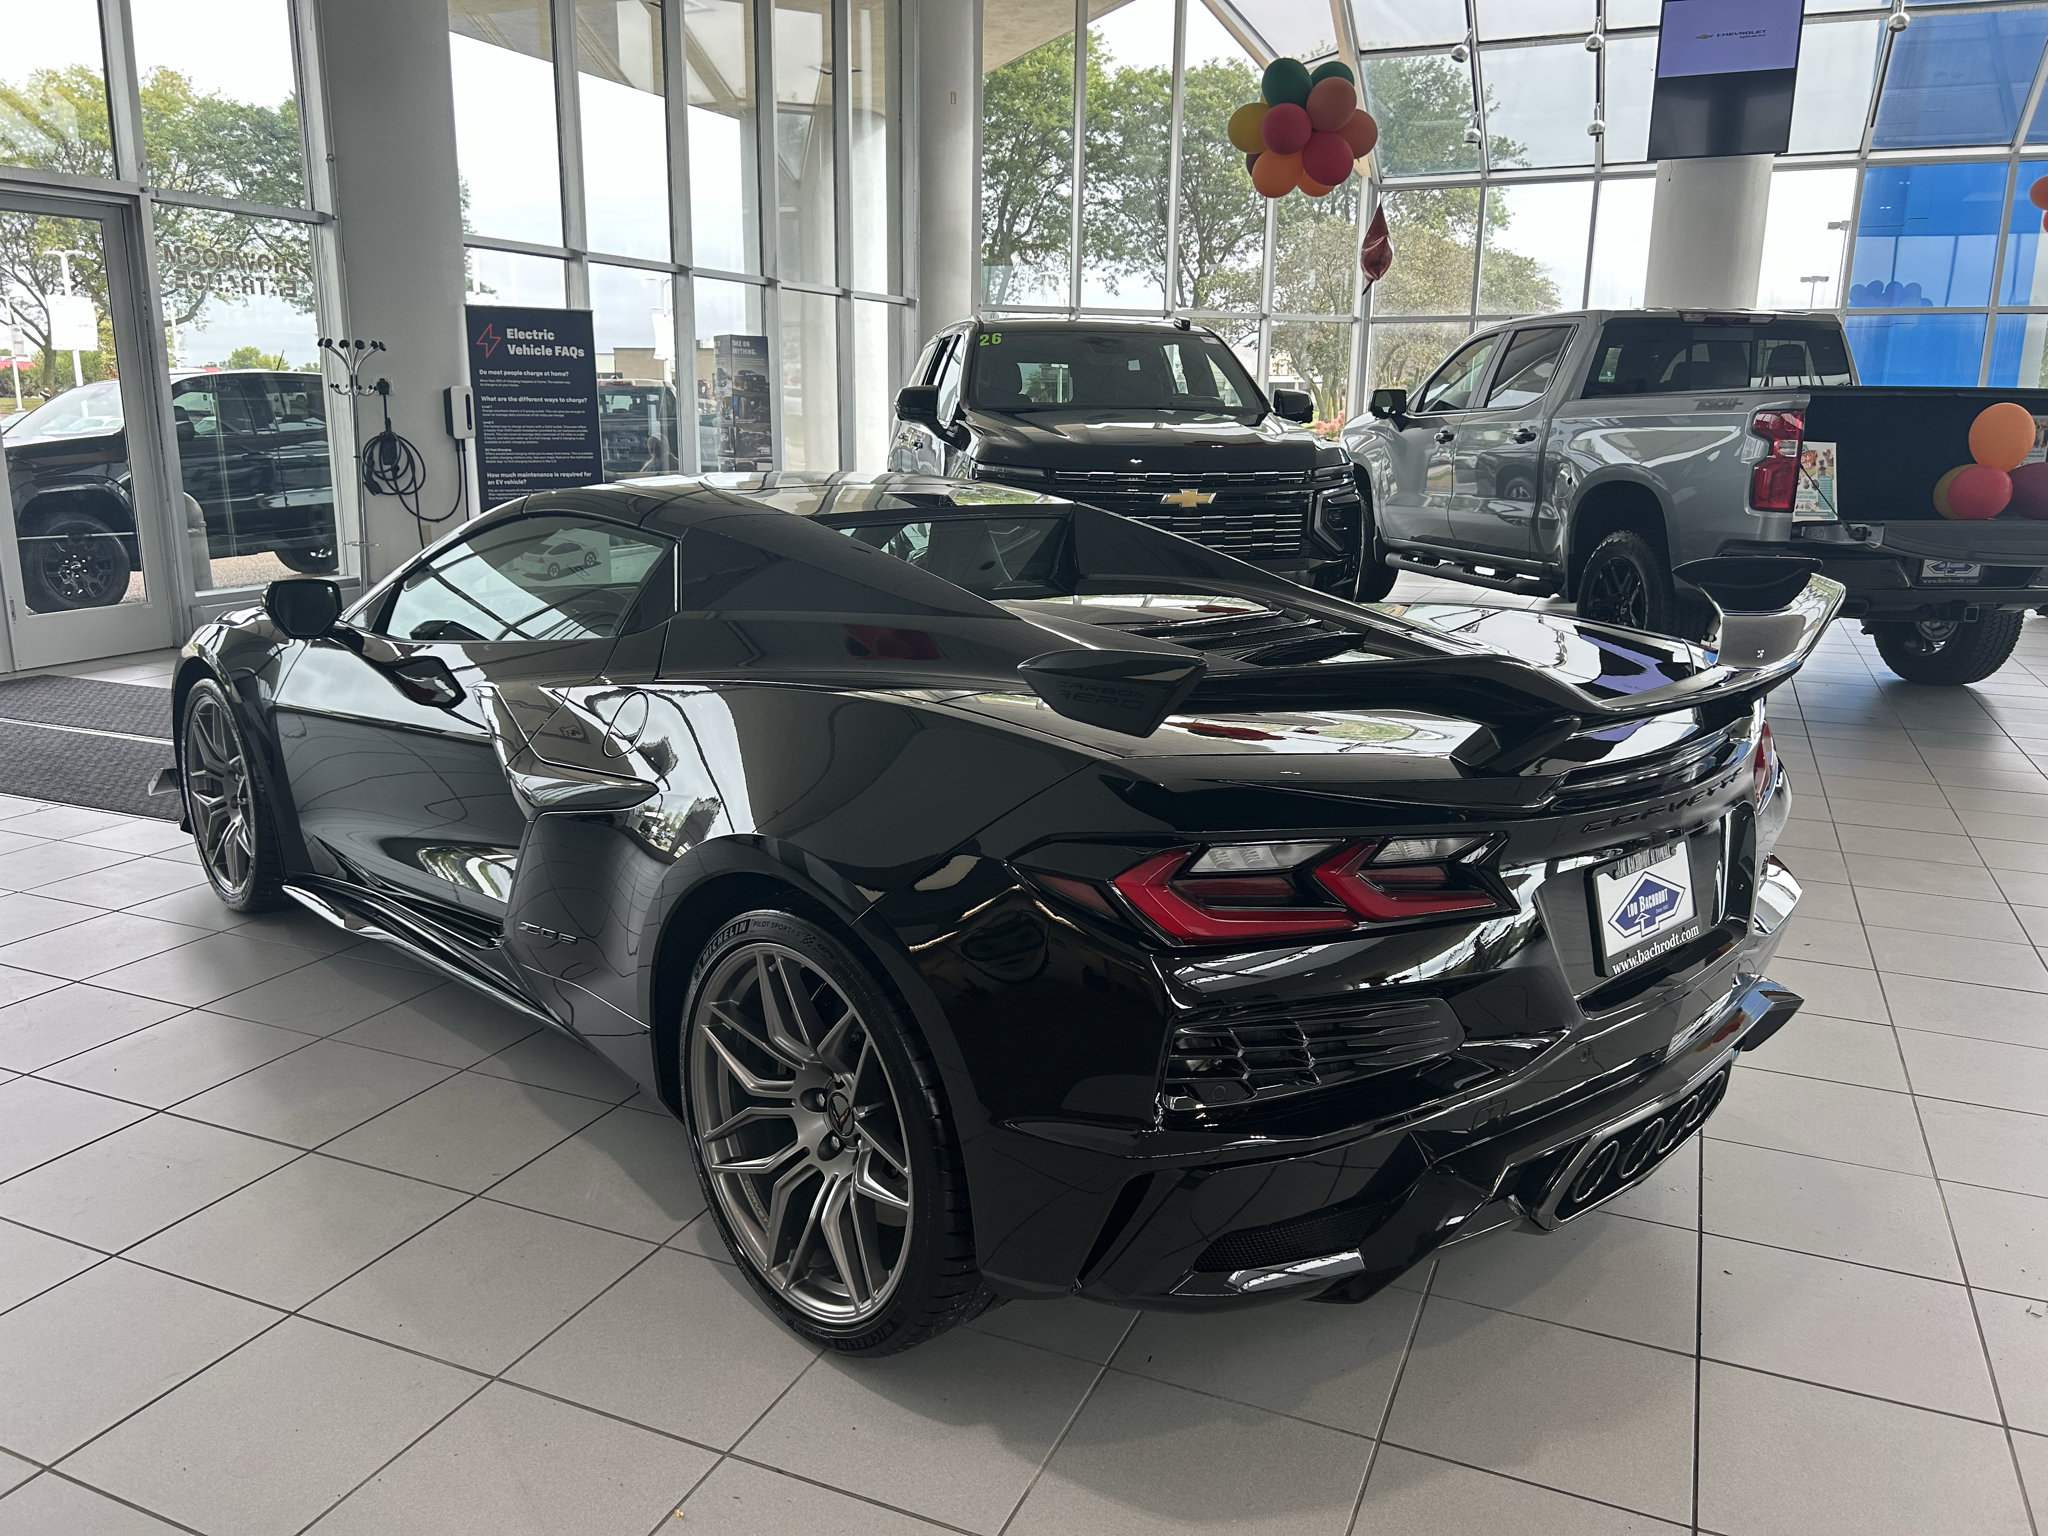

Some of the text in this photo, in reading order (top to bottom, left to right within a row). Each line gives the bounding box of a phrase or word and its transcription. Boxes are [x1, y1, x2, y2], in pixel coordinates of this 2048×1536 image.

[506, 328, 555, 340] Electric
[980, 333, 1002, 346] 26
[508, 344, 584, 358] Vehicle FAQs
[504, 370, 522, 378] people
[524, 370, 543, 378] charge
[518, 921, 577, 945] Z06
[702, 920, 748, 964] MICHELIN
[753, 920, 770, 928] PILOT
[771, 922, 791, 933] SPORT
[1612, 925, 1699, 974] www.bachrodt.com
